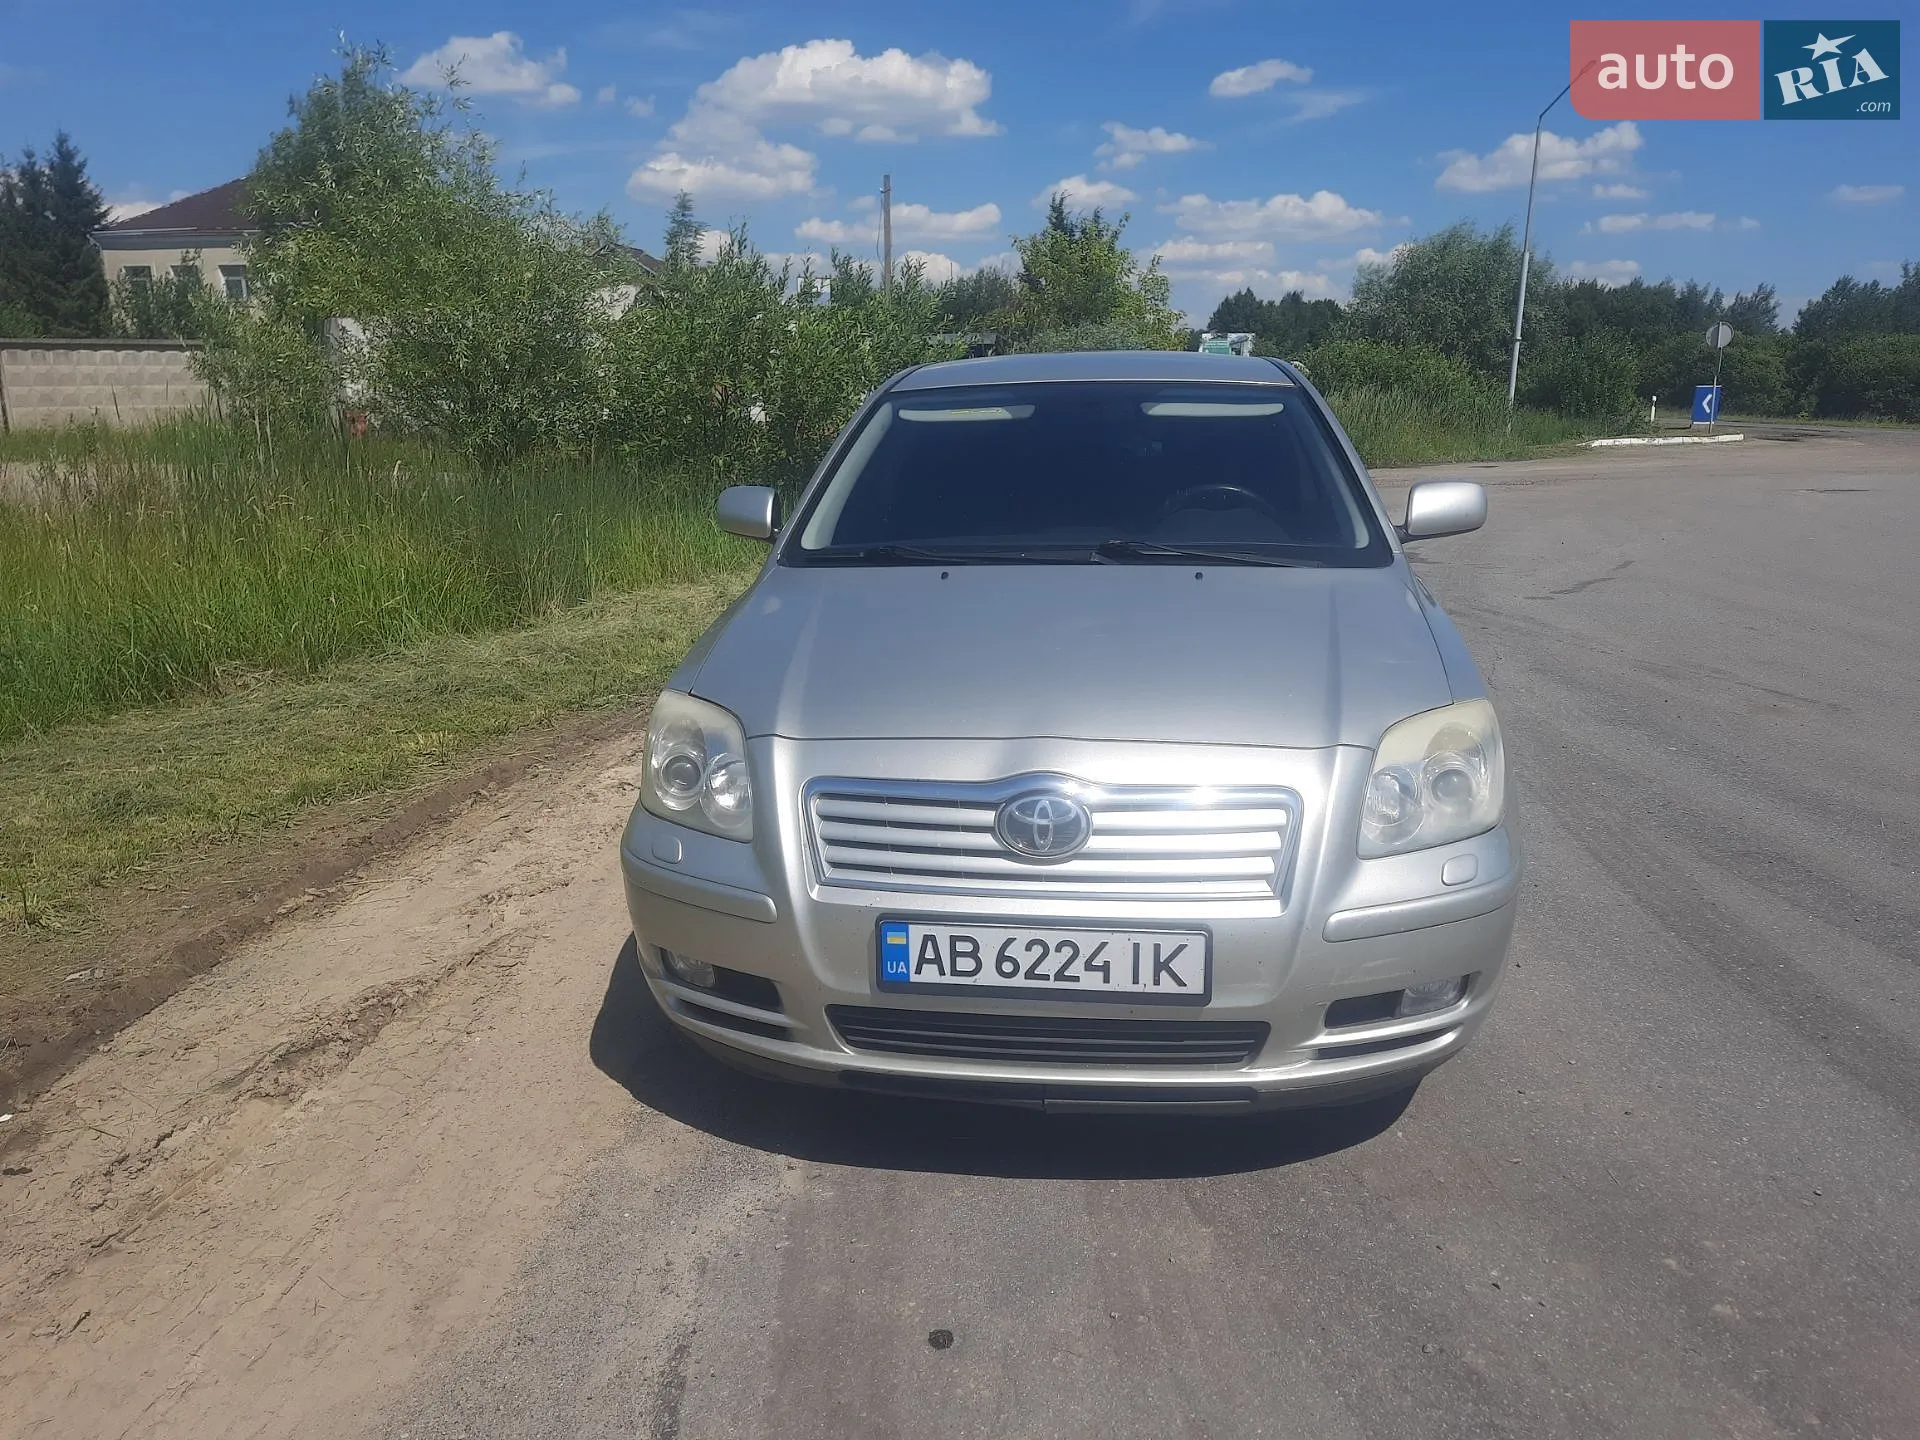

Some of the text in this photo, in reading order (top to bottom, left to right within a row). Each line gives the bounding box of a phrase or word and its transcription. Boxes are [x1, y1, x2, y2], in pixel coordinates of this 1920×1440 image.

[887, 961, 907, 973] UA
[914, 934, 1189, 987] AB 6224 IK
